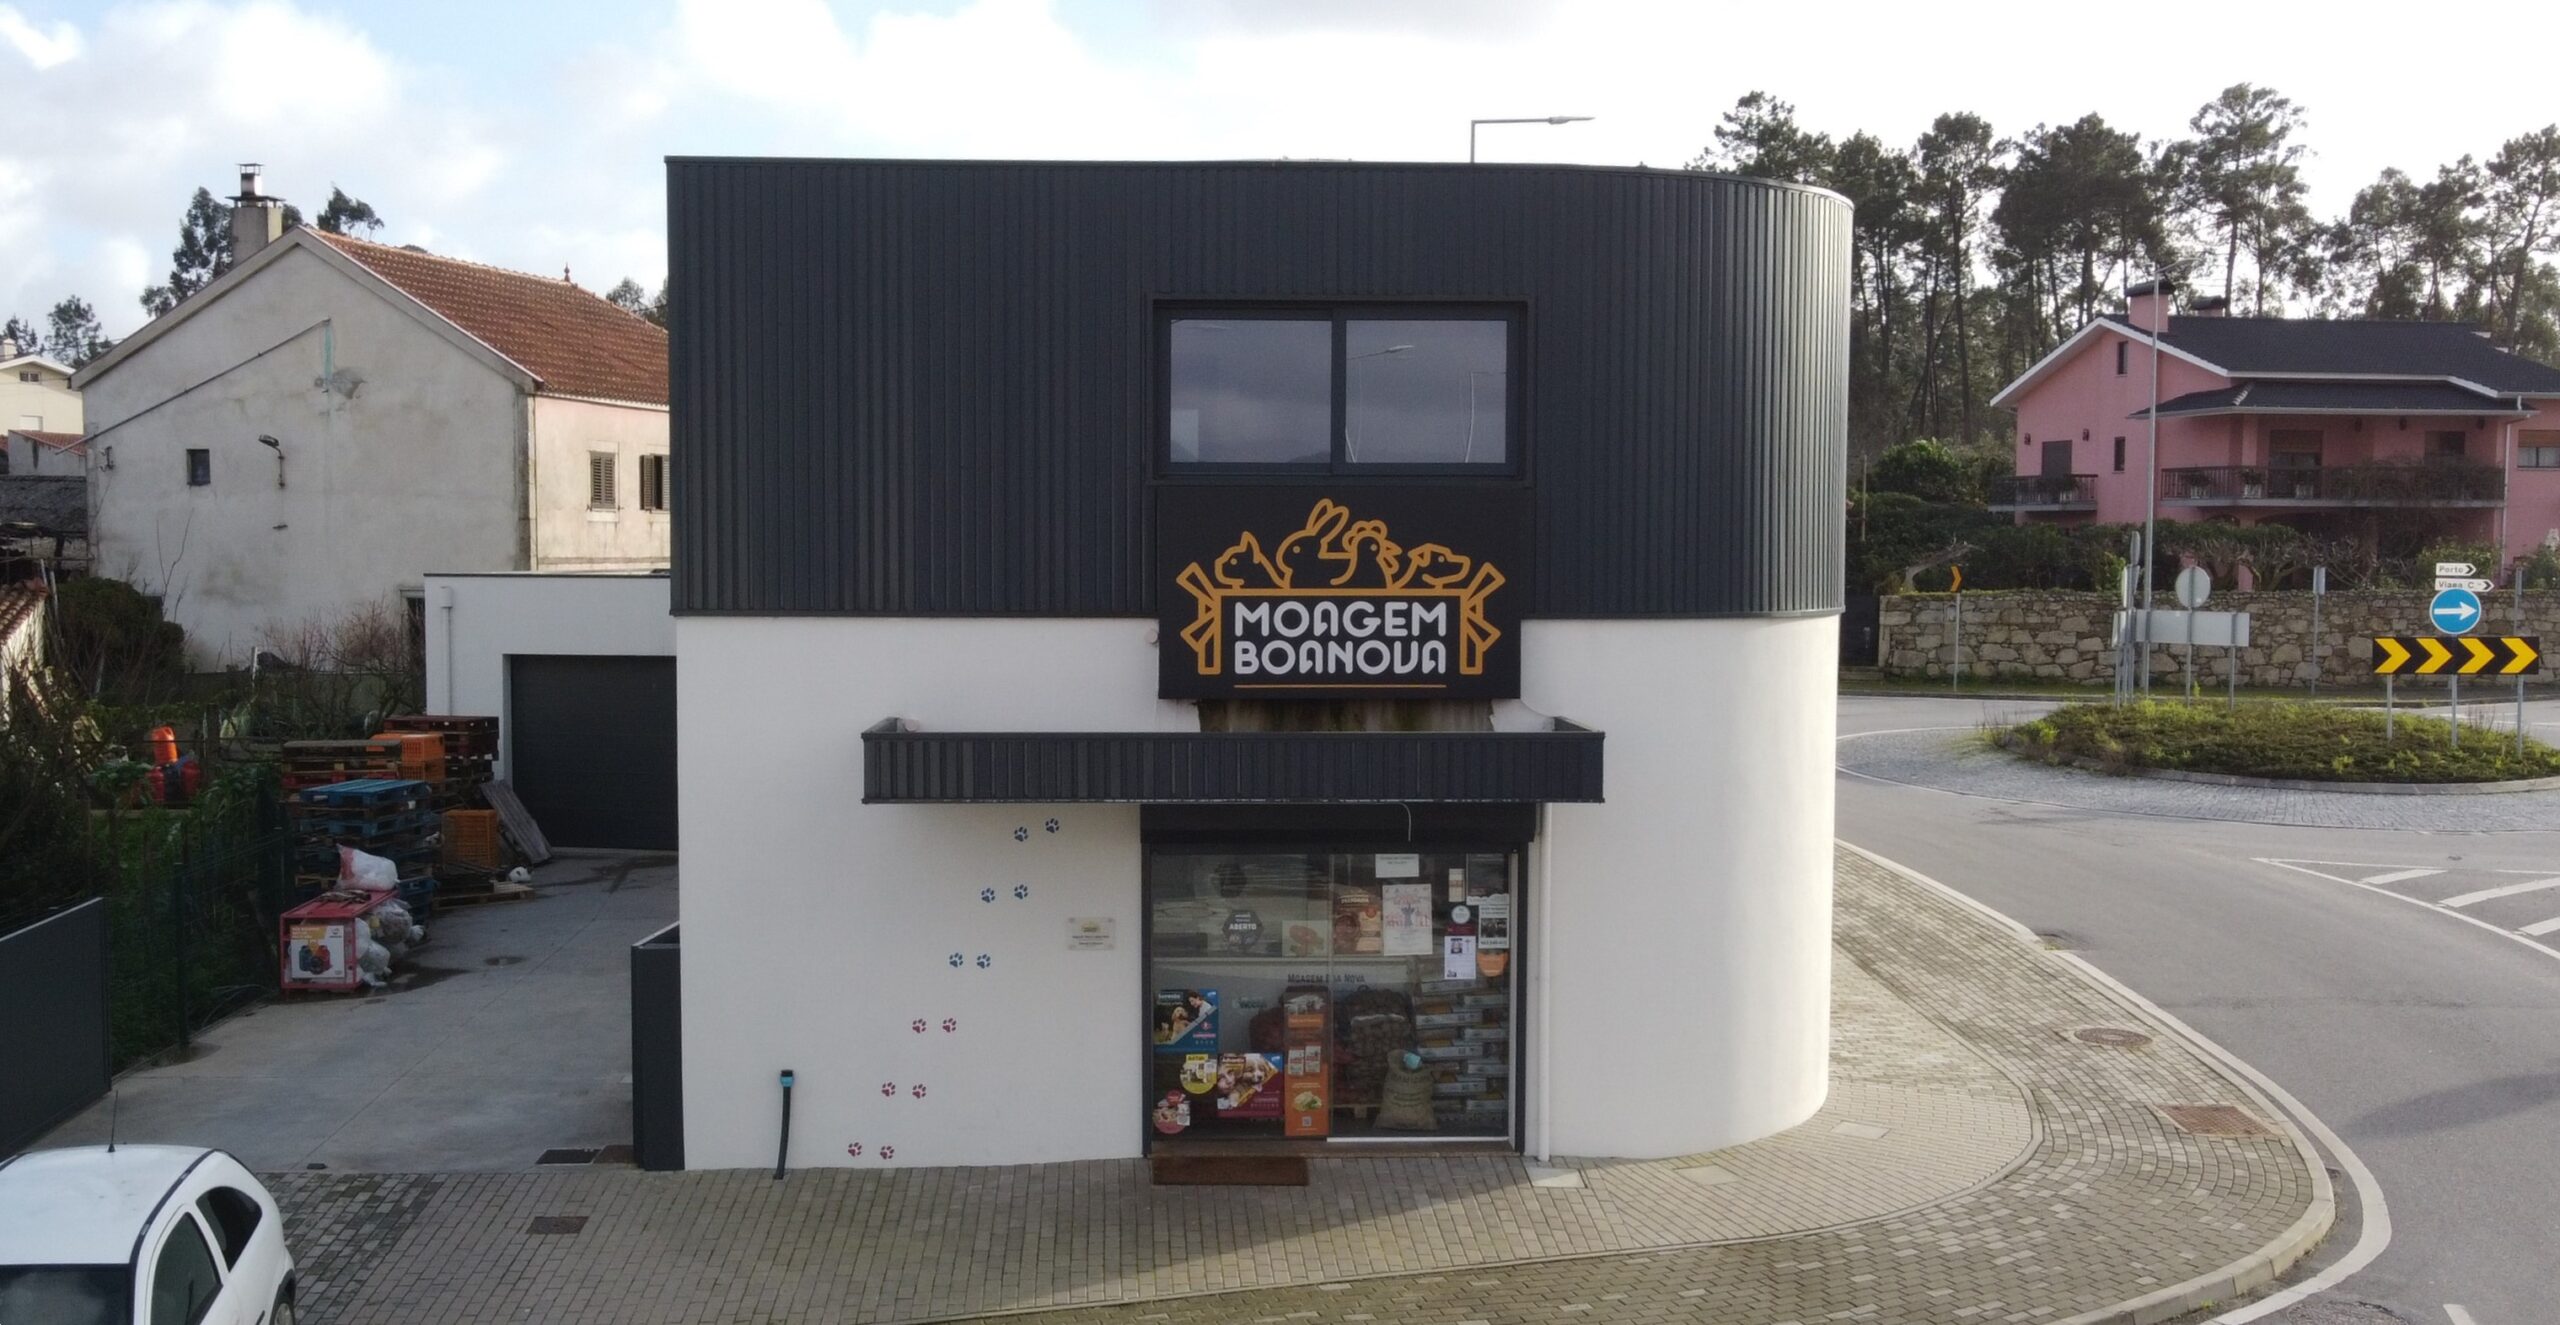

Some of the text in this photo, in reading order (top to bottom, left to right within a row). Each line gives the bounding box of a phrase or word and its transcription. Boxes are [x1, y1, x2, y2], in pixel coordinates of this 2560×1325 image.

[2439, 565, 2464, 573] Porto
[1234, 600, 1447, 637] MOAGEM
[1234, 639, 1447, 675] BOANOVA
